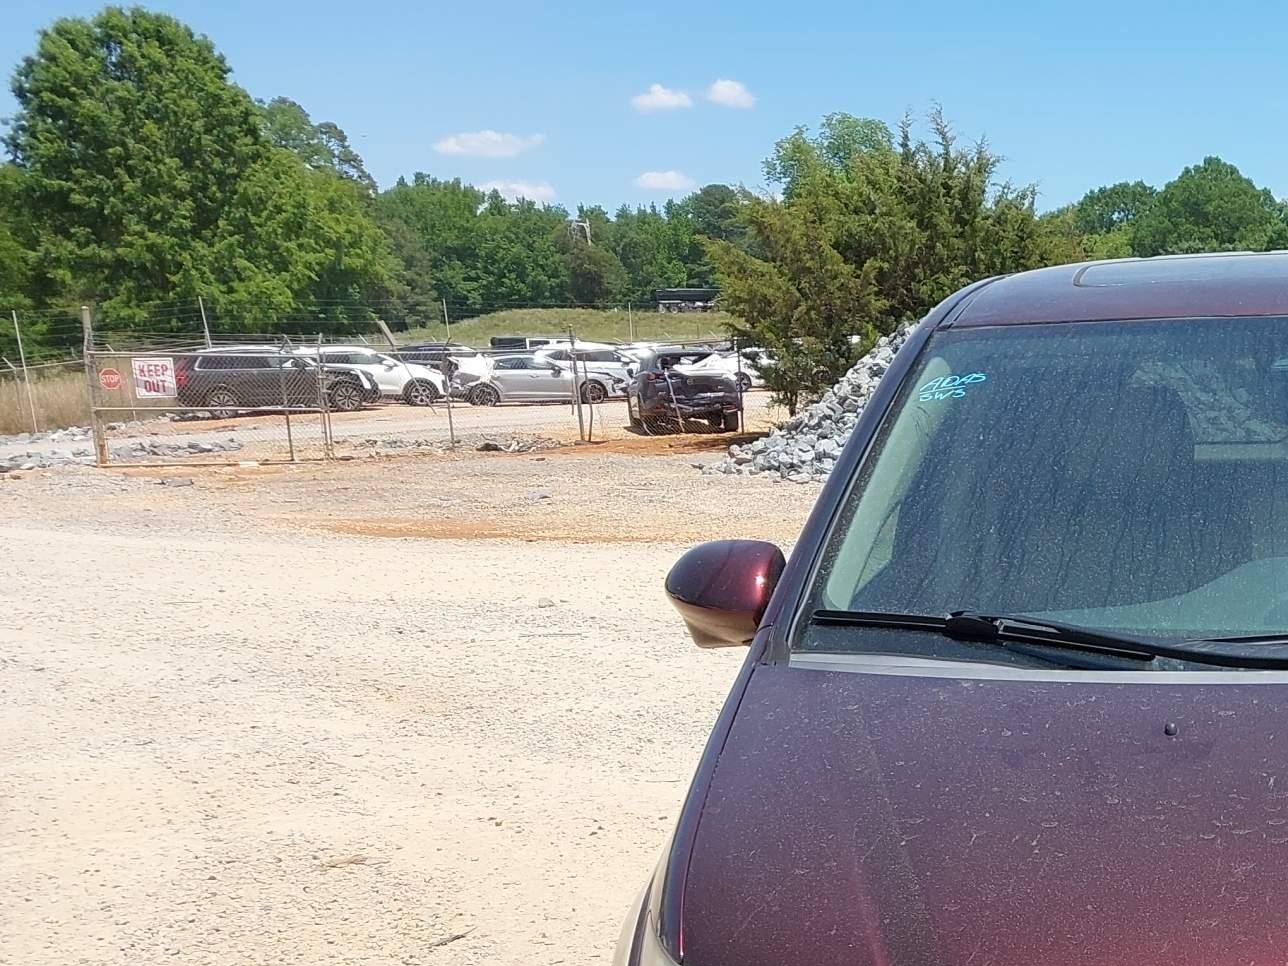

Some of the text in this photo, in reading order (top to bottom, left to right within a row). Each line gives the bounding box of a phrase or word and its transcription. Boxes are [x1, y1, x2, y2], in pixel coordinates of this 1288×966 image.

[138, 363, 168, 377] KEEP
[101, 374, 120, 383] STOP
[919, 373, 987, 391] ADAS
[144, 380, 167, 392] OUT
